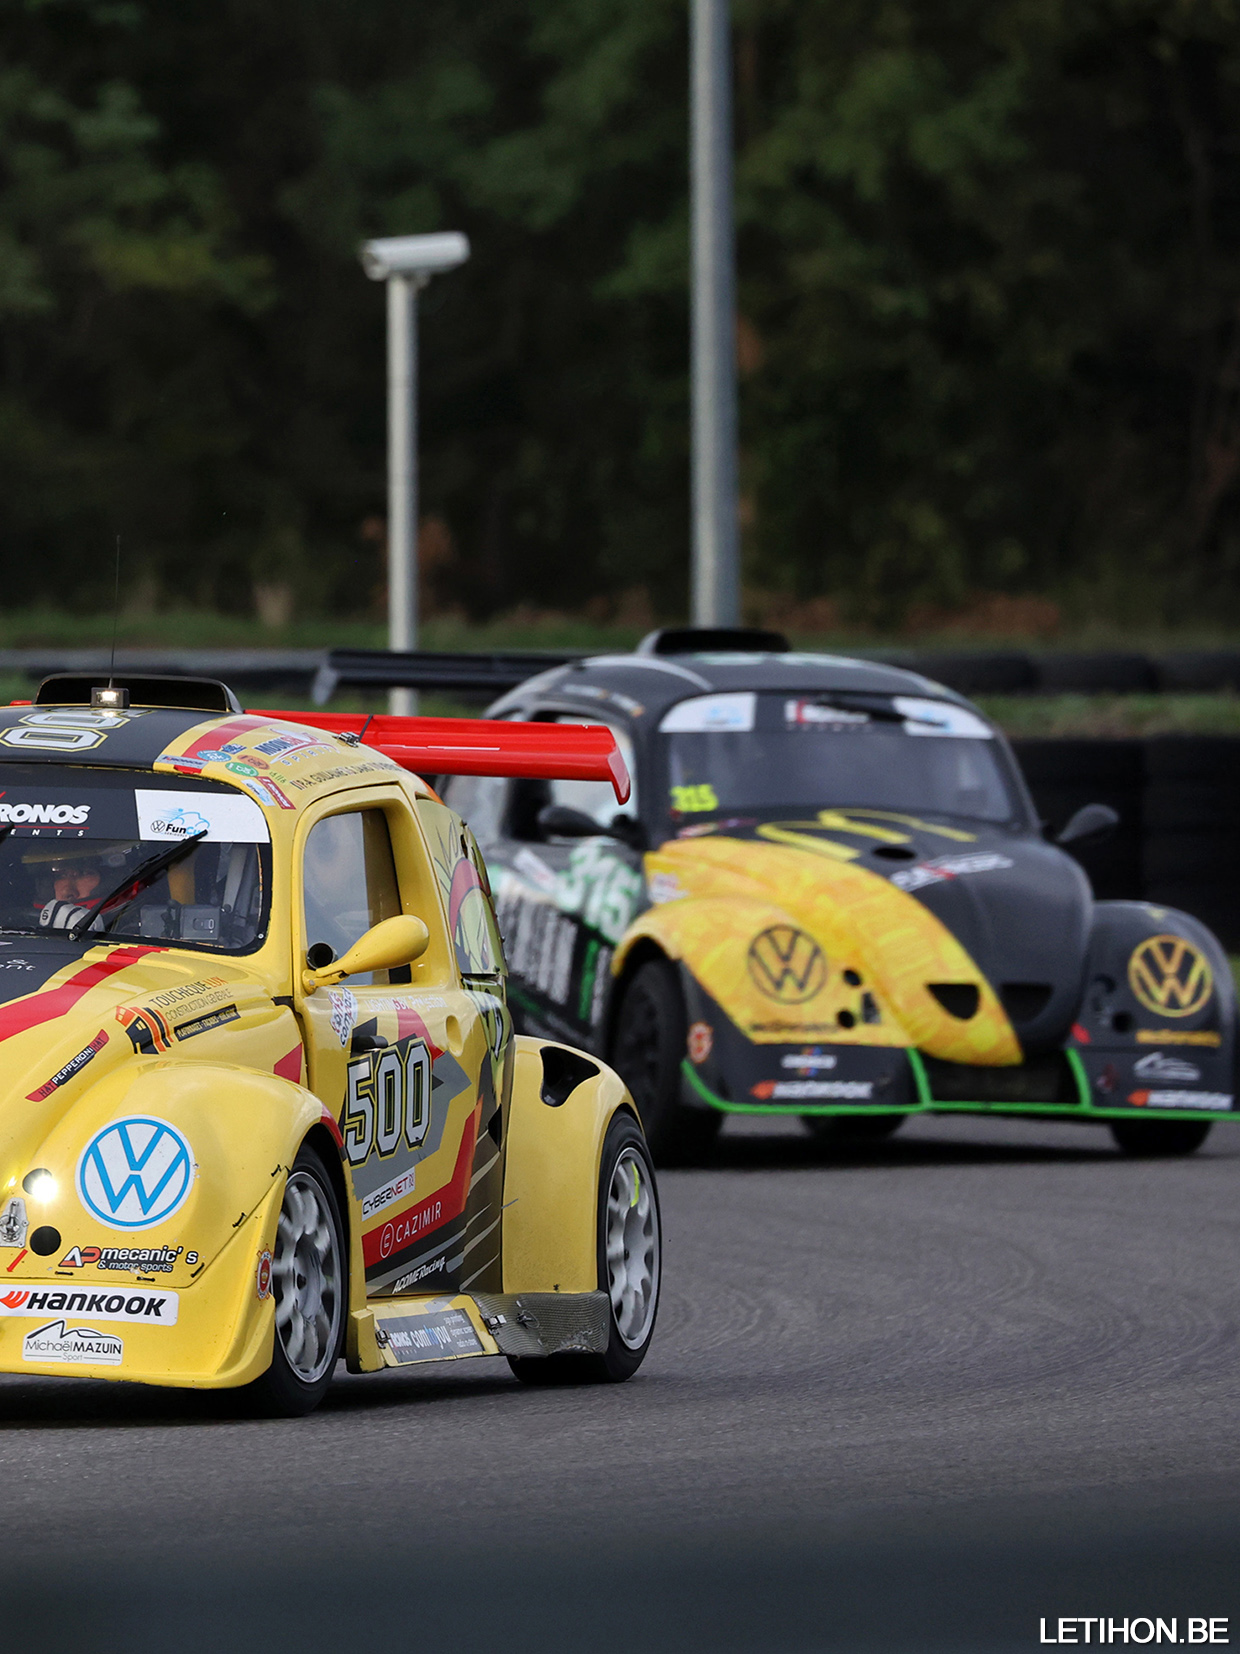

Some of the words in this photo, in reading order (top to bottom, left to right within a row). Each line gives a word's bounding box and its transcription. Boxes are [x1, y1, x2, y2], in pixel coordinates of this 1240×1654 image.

[51, 1047, 94, 1084] PEPPERONI
[38, 1082, 55, 1097] HAT
[343, 1037, 432, 1169] 500
[396, 1201, 442, 1243] CAZIMIR
[59, 1246, 101, 1268] AP
[98, 1260, 106, 1269] &
[109, 1261, 138, 1271] motor
[141, 1262, 173, 1273] sports
[62, 1352, 83, 1362] Sport
